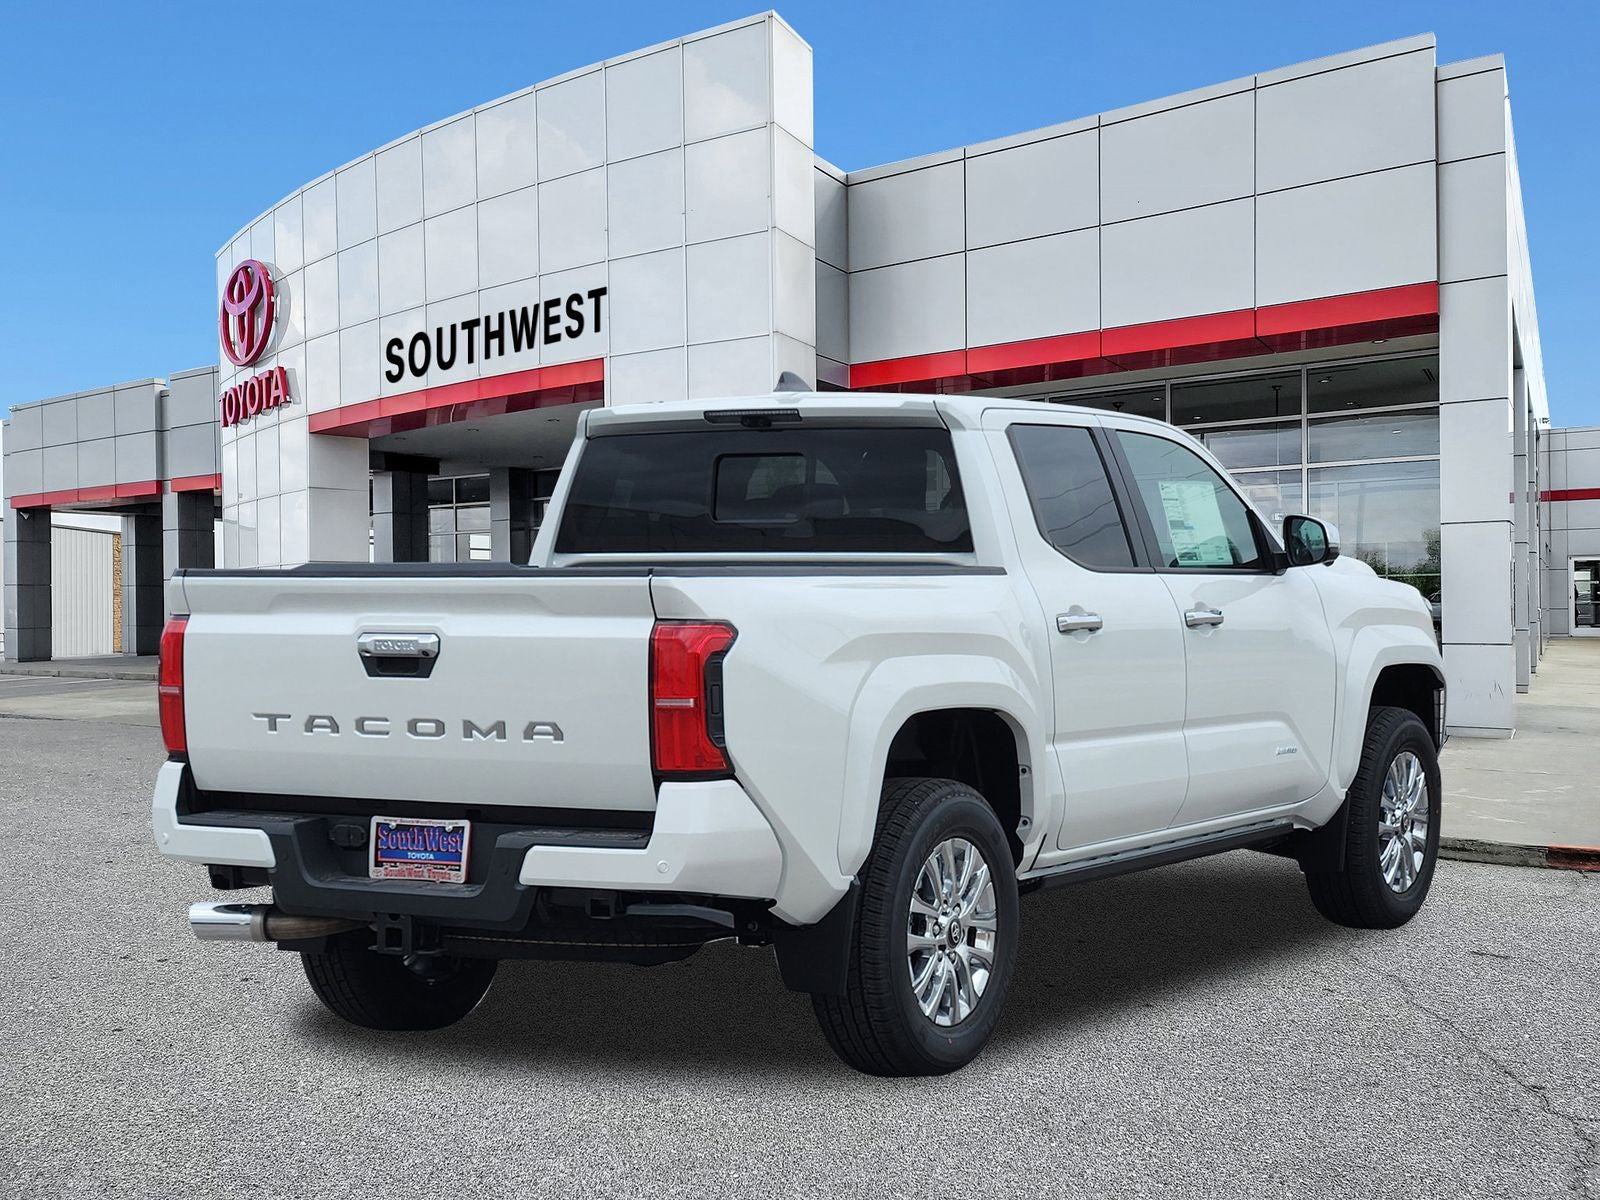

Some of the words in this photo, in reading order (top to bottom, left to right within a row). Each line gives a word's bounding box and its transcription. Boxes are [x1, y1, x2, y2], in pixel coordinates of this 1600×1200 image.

[385, 287, 608, 384] SOUTHWEST
[219, 366, 291, 428] TOYOTA
[375, 640, 416, 652] TOYOTA
[252, 712, 565, 744] TACOMA
[377, 824, 463, 853] SouthWest
[407, 852, 435, 860] TOYOTA
